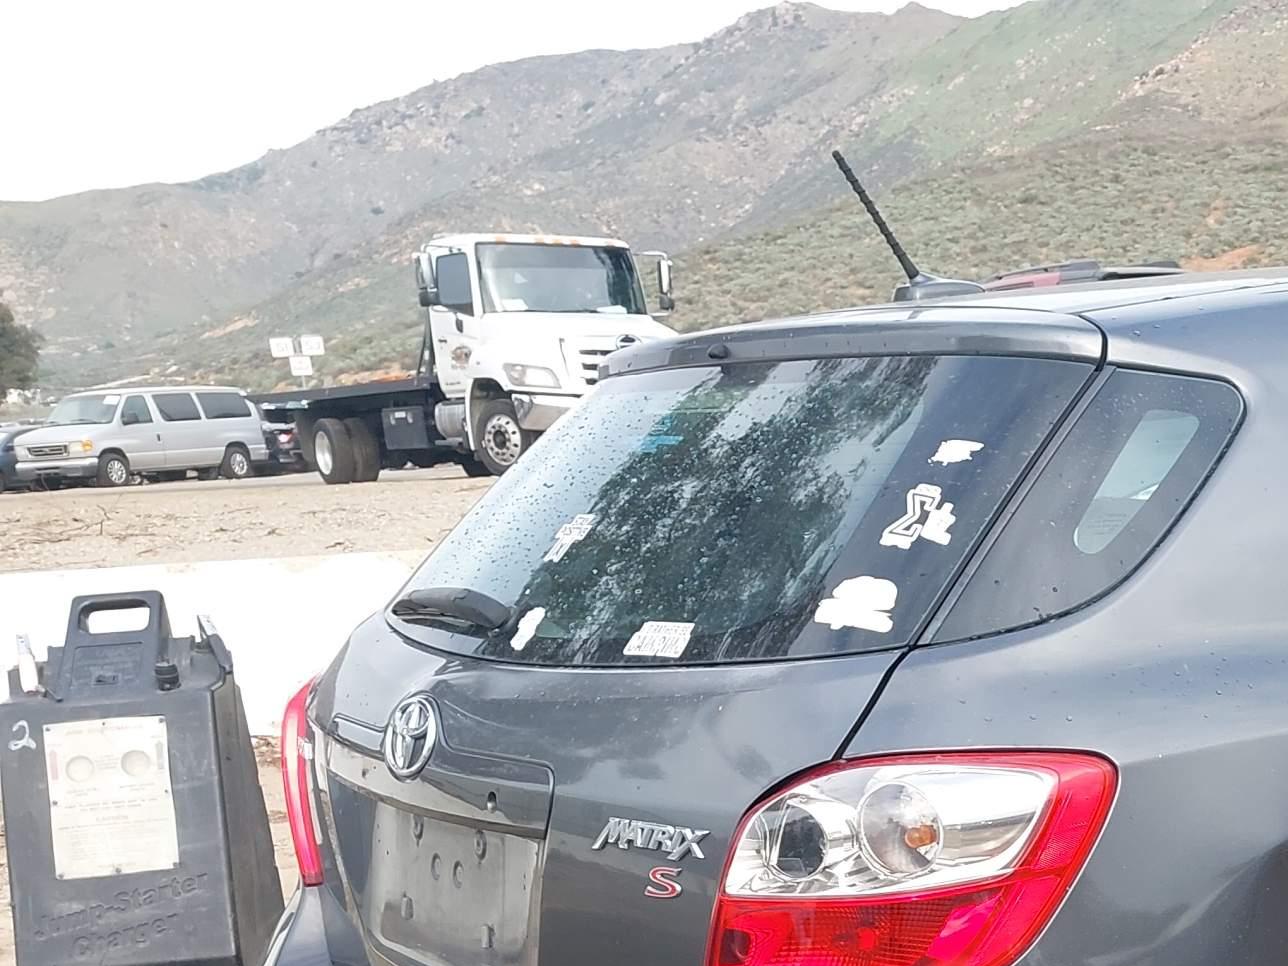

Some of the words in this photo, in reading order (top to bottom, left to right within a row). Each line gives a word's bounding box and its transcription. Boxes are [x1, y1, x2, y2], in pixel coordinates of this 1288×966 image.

[8, 719, 37, 751] 2
[592, 816, 711, 861] MATRIX
[644, 866, 683, 898] S
